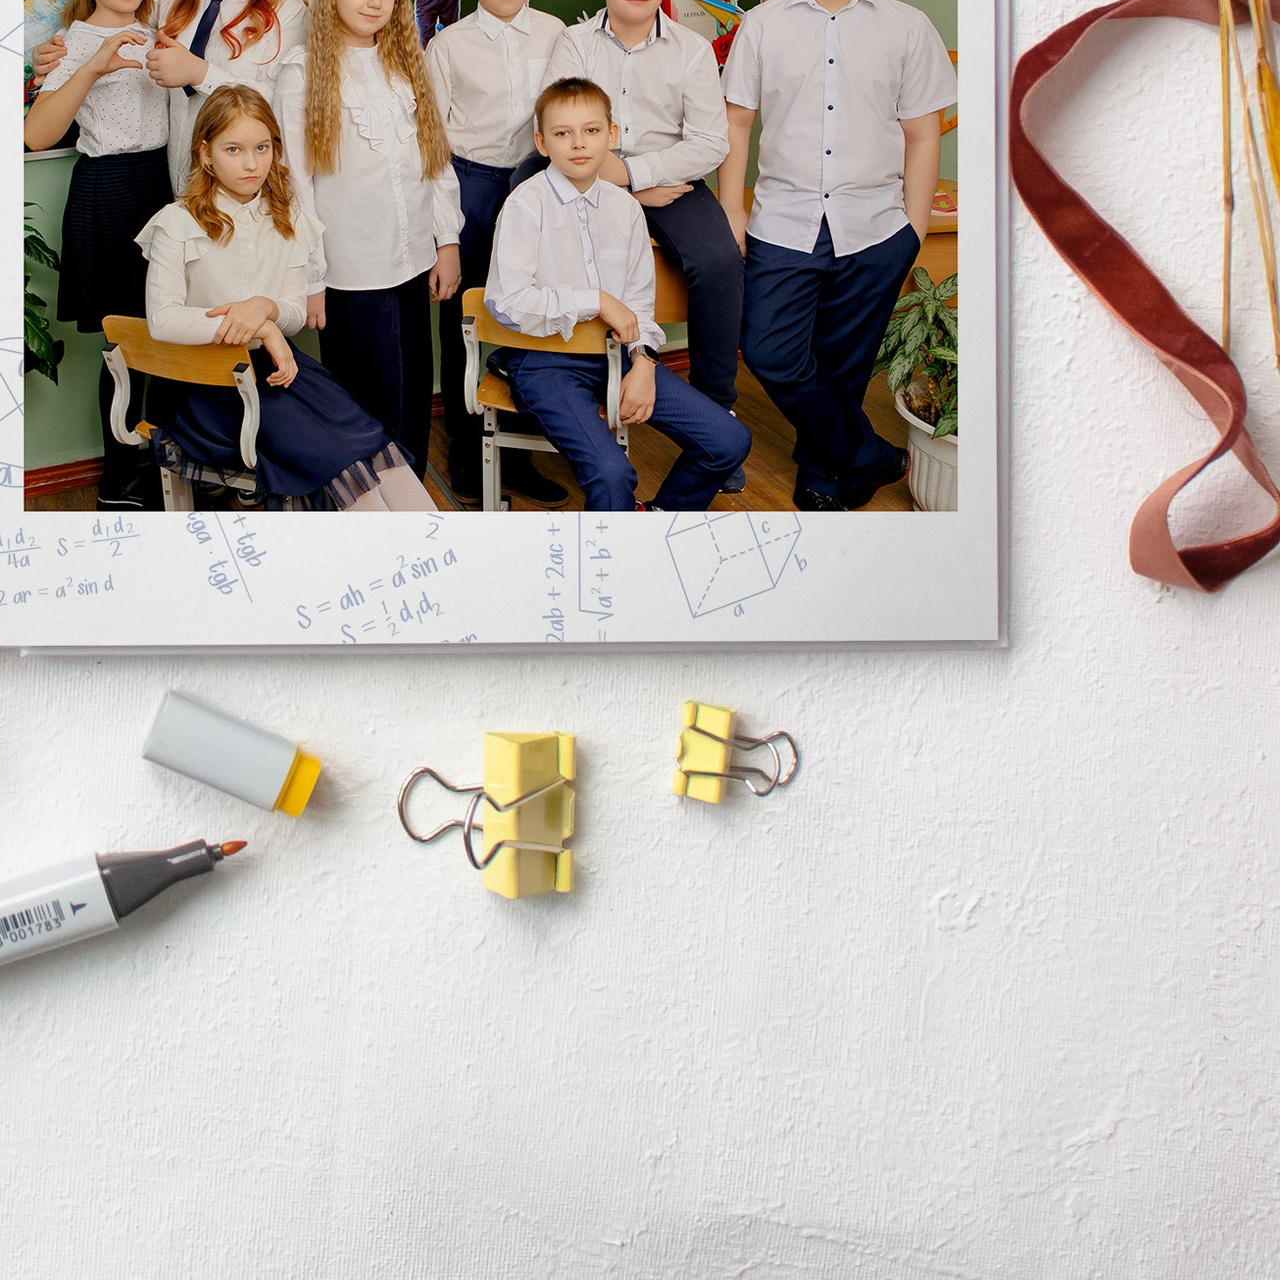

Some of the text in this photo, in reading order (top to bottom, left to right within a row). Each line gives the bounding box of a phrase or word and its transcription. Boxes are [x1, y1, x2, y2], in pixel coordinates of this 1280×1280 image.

[761, 520, 771, 534] c
[56, 537, 69, 557] S
[110, 539, 123, 558] 2
[6, 553, 32, 570] 4a
[545, 543, 566, 579] 2ac
[793, 553, 808, 572] b
[76, 578, 99, 597] sin
[295, 604, 313, 629] S
[339, 583, 366, 611] ah
[410, 556, 439, 581] sin
[8, 916, 63, 944] 001783
